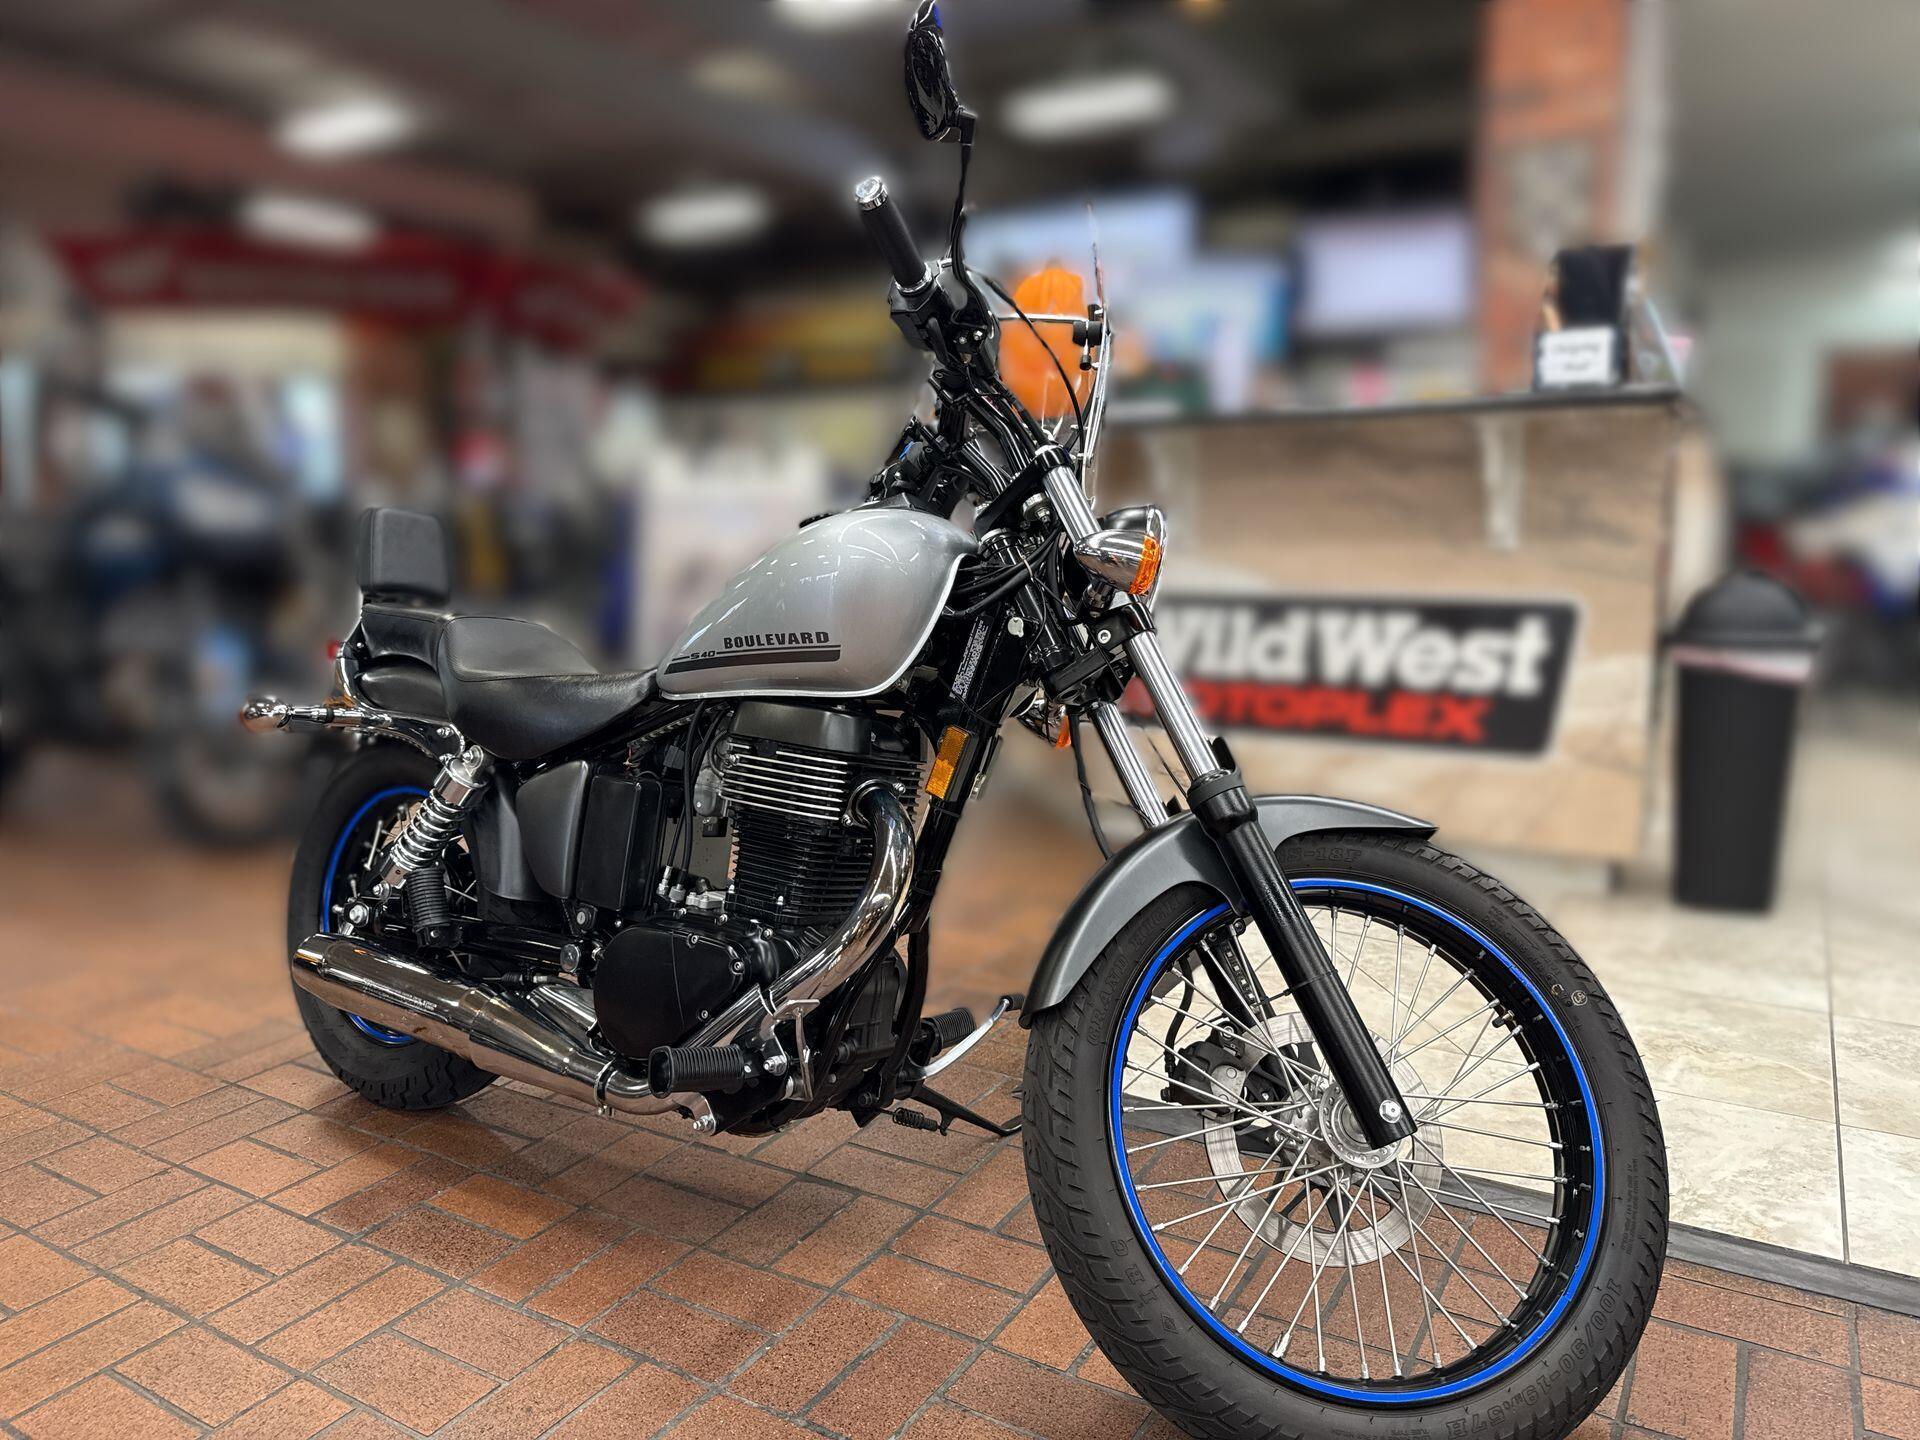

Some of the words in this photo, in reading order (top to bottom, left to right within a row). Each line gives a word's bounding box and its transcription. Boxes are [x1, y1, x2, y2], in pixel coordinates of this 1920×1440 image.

[690, 650, 716, 660] S40
[723, 631, 830, 650] BOULEVARD
[1311, 608, 1551, 698] West
[1086, 953, 1129, 1046] GRAND
